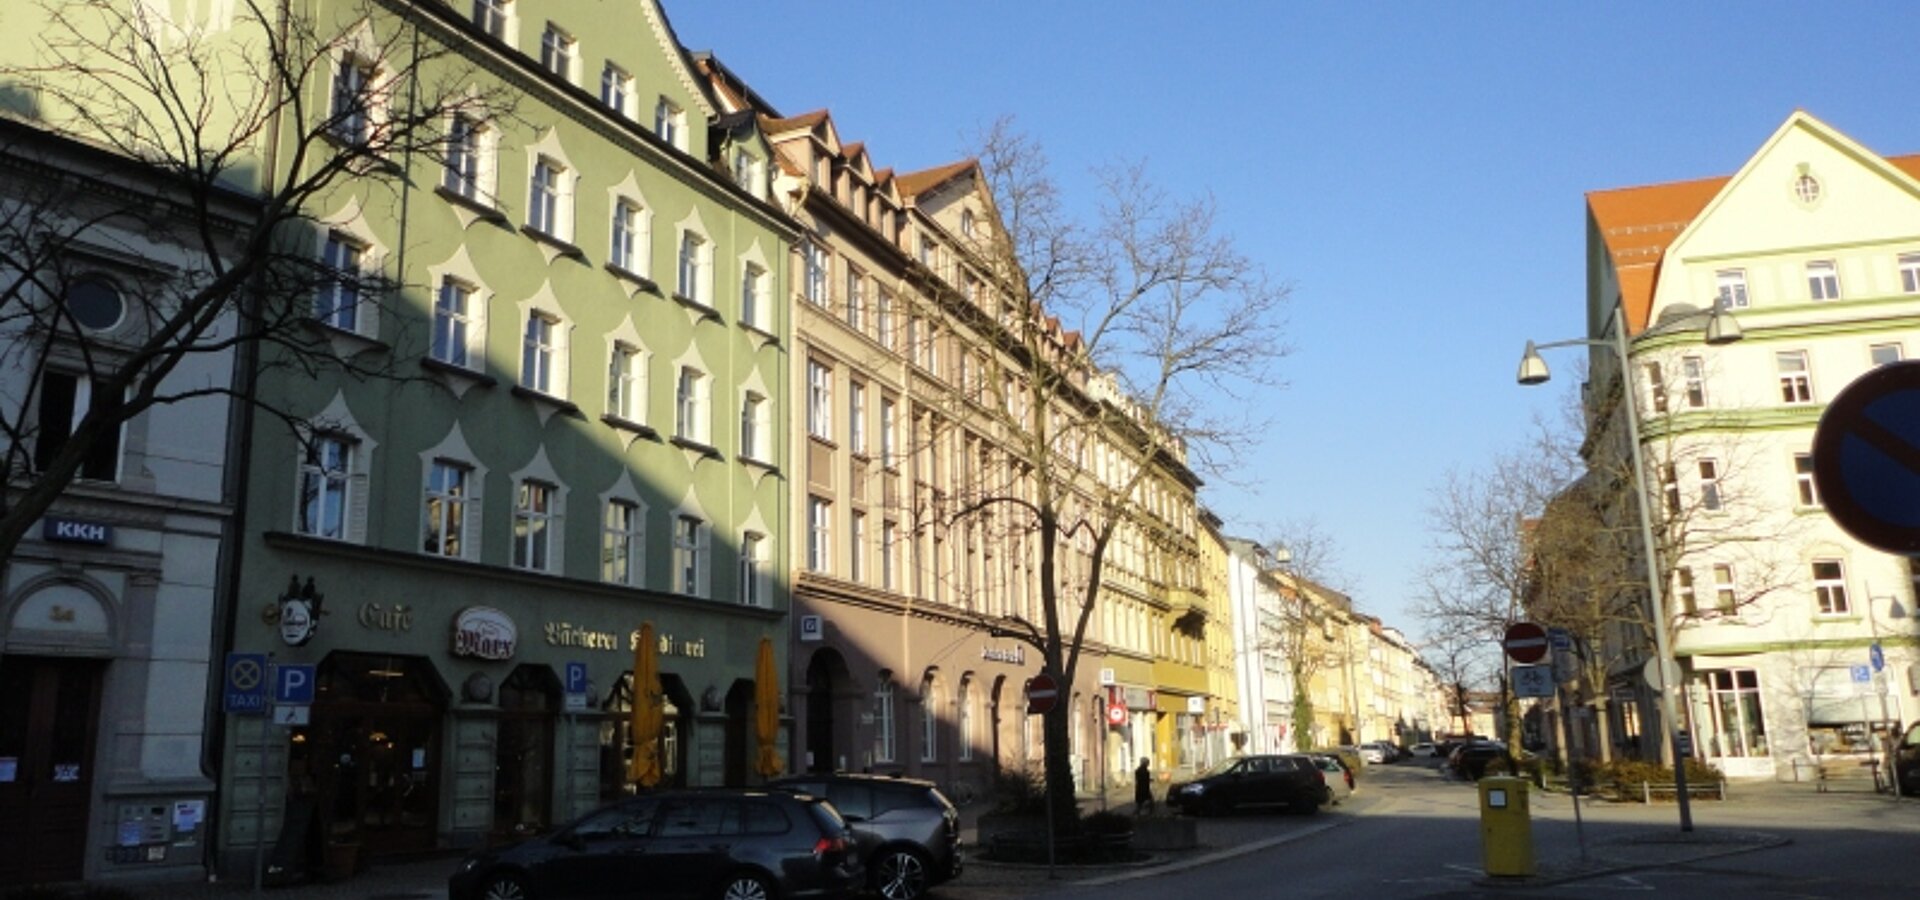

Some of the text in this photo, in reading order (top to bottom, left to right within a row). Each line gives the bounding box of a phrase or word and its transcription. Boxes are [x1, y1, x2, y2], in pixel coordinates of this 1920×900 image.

[57, 521, 105, 540] KKH
[284, 669, 306, 698] P
[570, 666, 582, 691] P
[228, 693, 260, 707] TAXI
